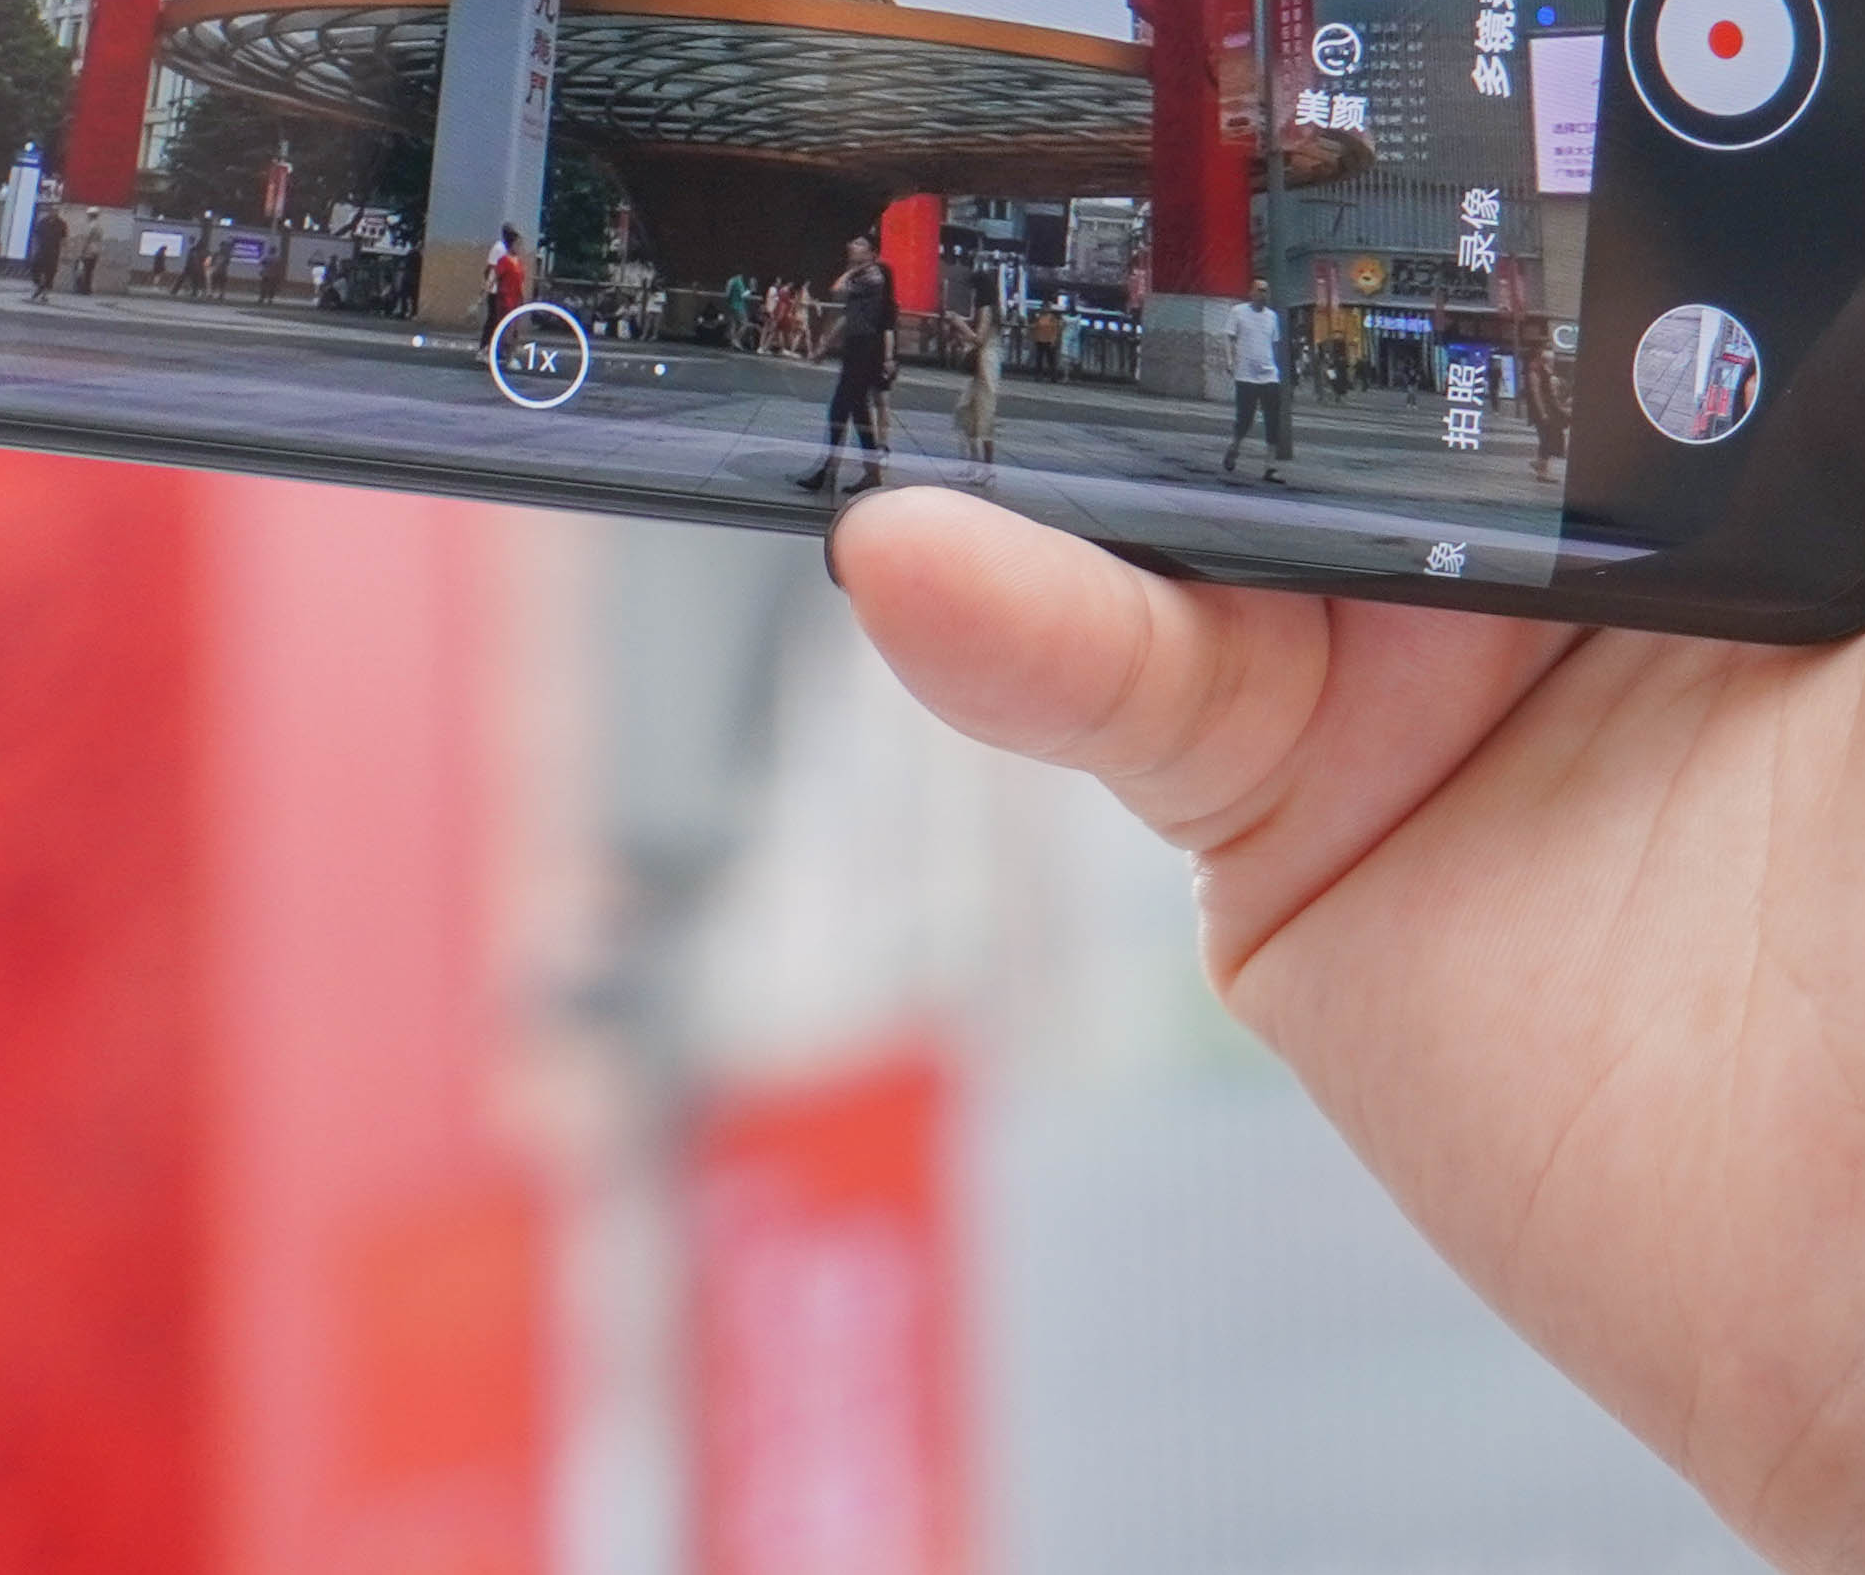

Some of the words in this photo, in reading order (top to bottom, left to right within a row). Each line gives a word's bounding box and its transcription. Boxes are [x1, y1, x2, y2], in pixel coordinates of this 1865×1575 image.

[1295, 90, 1367, 133] 美颜
[1459, 189, 1500, 273] 录像
[523, 341, 559, 372] 1x
[1442, 364, 1486, 451] 拍照
